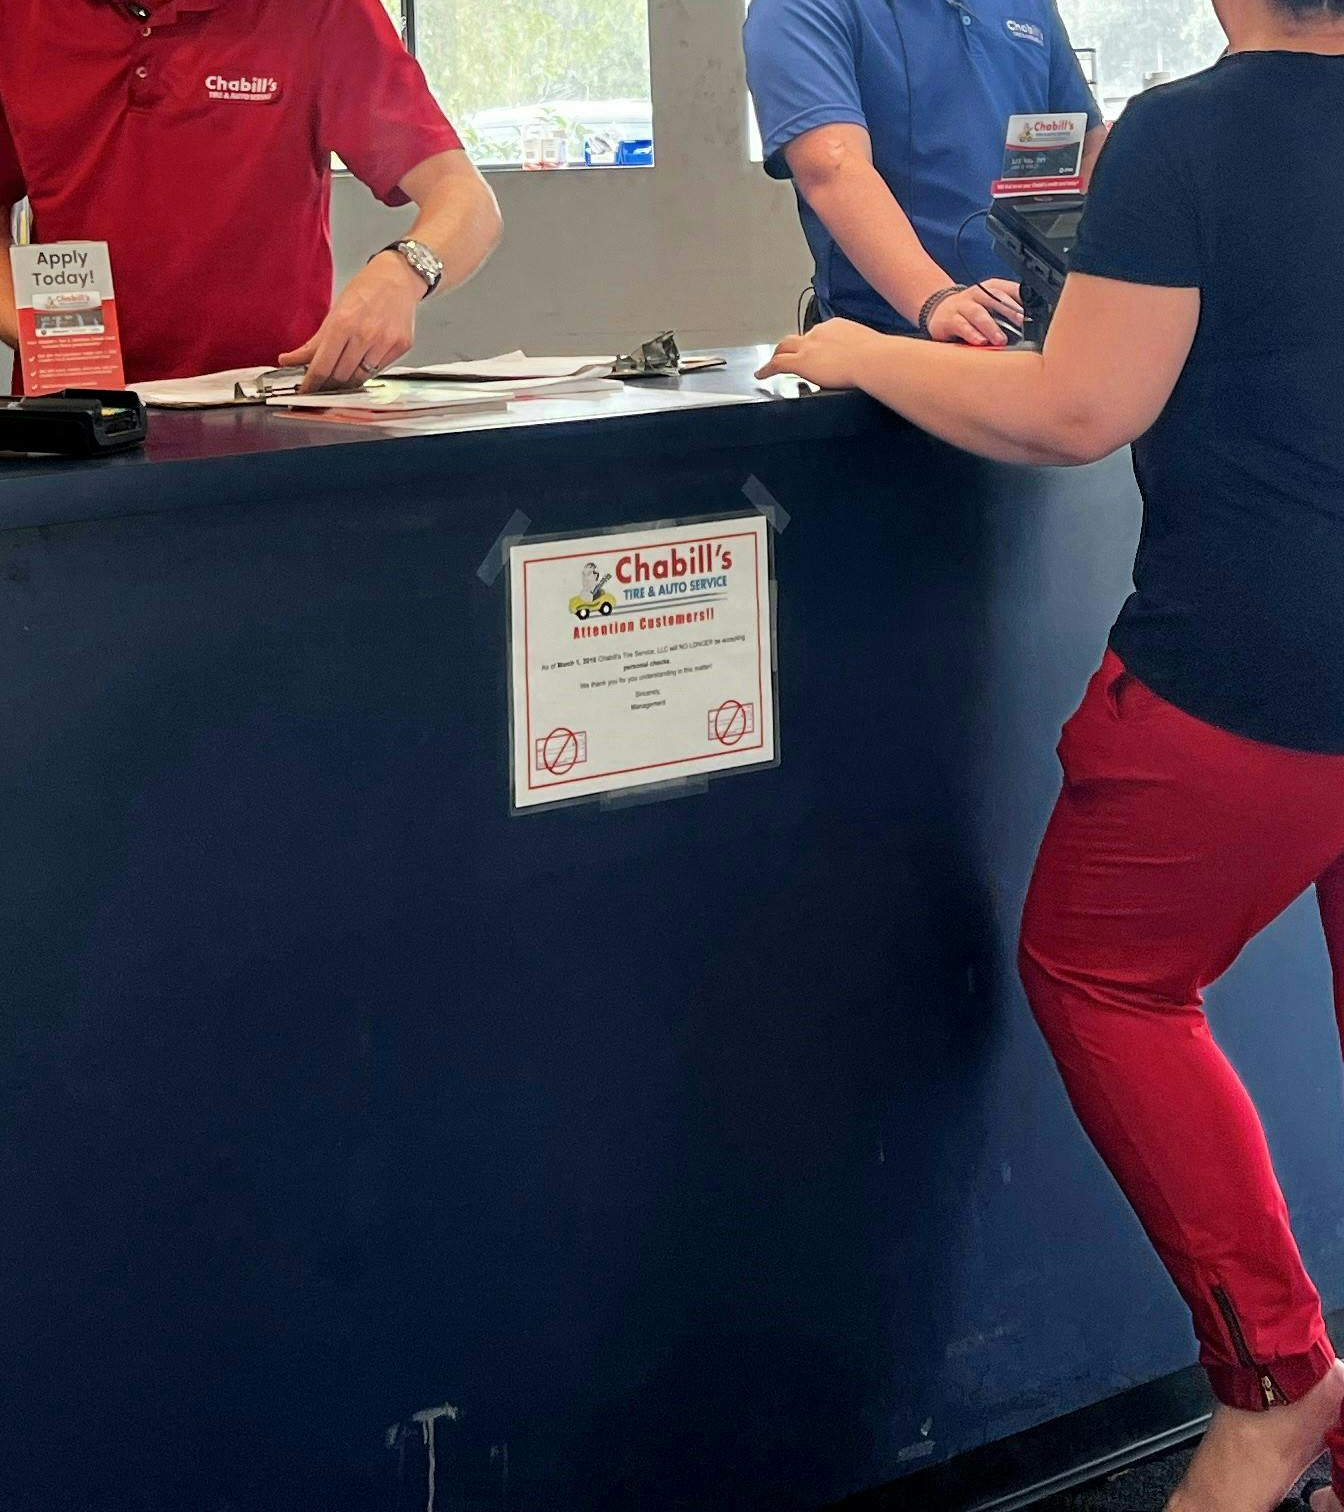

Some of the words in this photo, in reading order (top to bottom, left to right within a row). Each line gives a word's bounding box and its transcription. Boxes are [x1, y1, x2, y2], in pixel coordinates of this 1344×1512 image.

[204, 75, 278, 93] Chabill's
[1034, 120, 1074, 131] Chabill's
[37, 250, 88, 269] Apply
[32, 270, 95, 288] Today!
[616, 544, 733, 584] Chabill's
[623, 588, 645, 601] TIRE
[647, 586, 656, 597] &
[658, 582, 687, 597] AUTO
[689, 575, 727, 592] SERVICE
[573, 620, 635, 640] Attention
[640, 607, 714, 630] Customers!!
